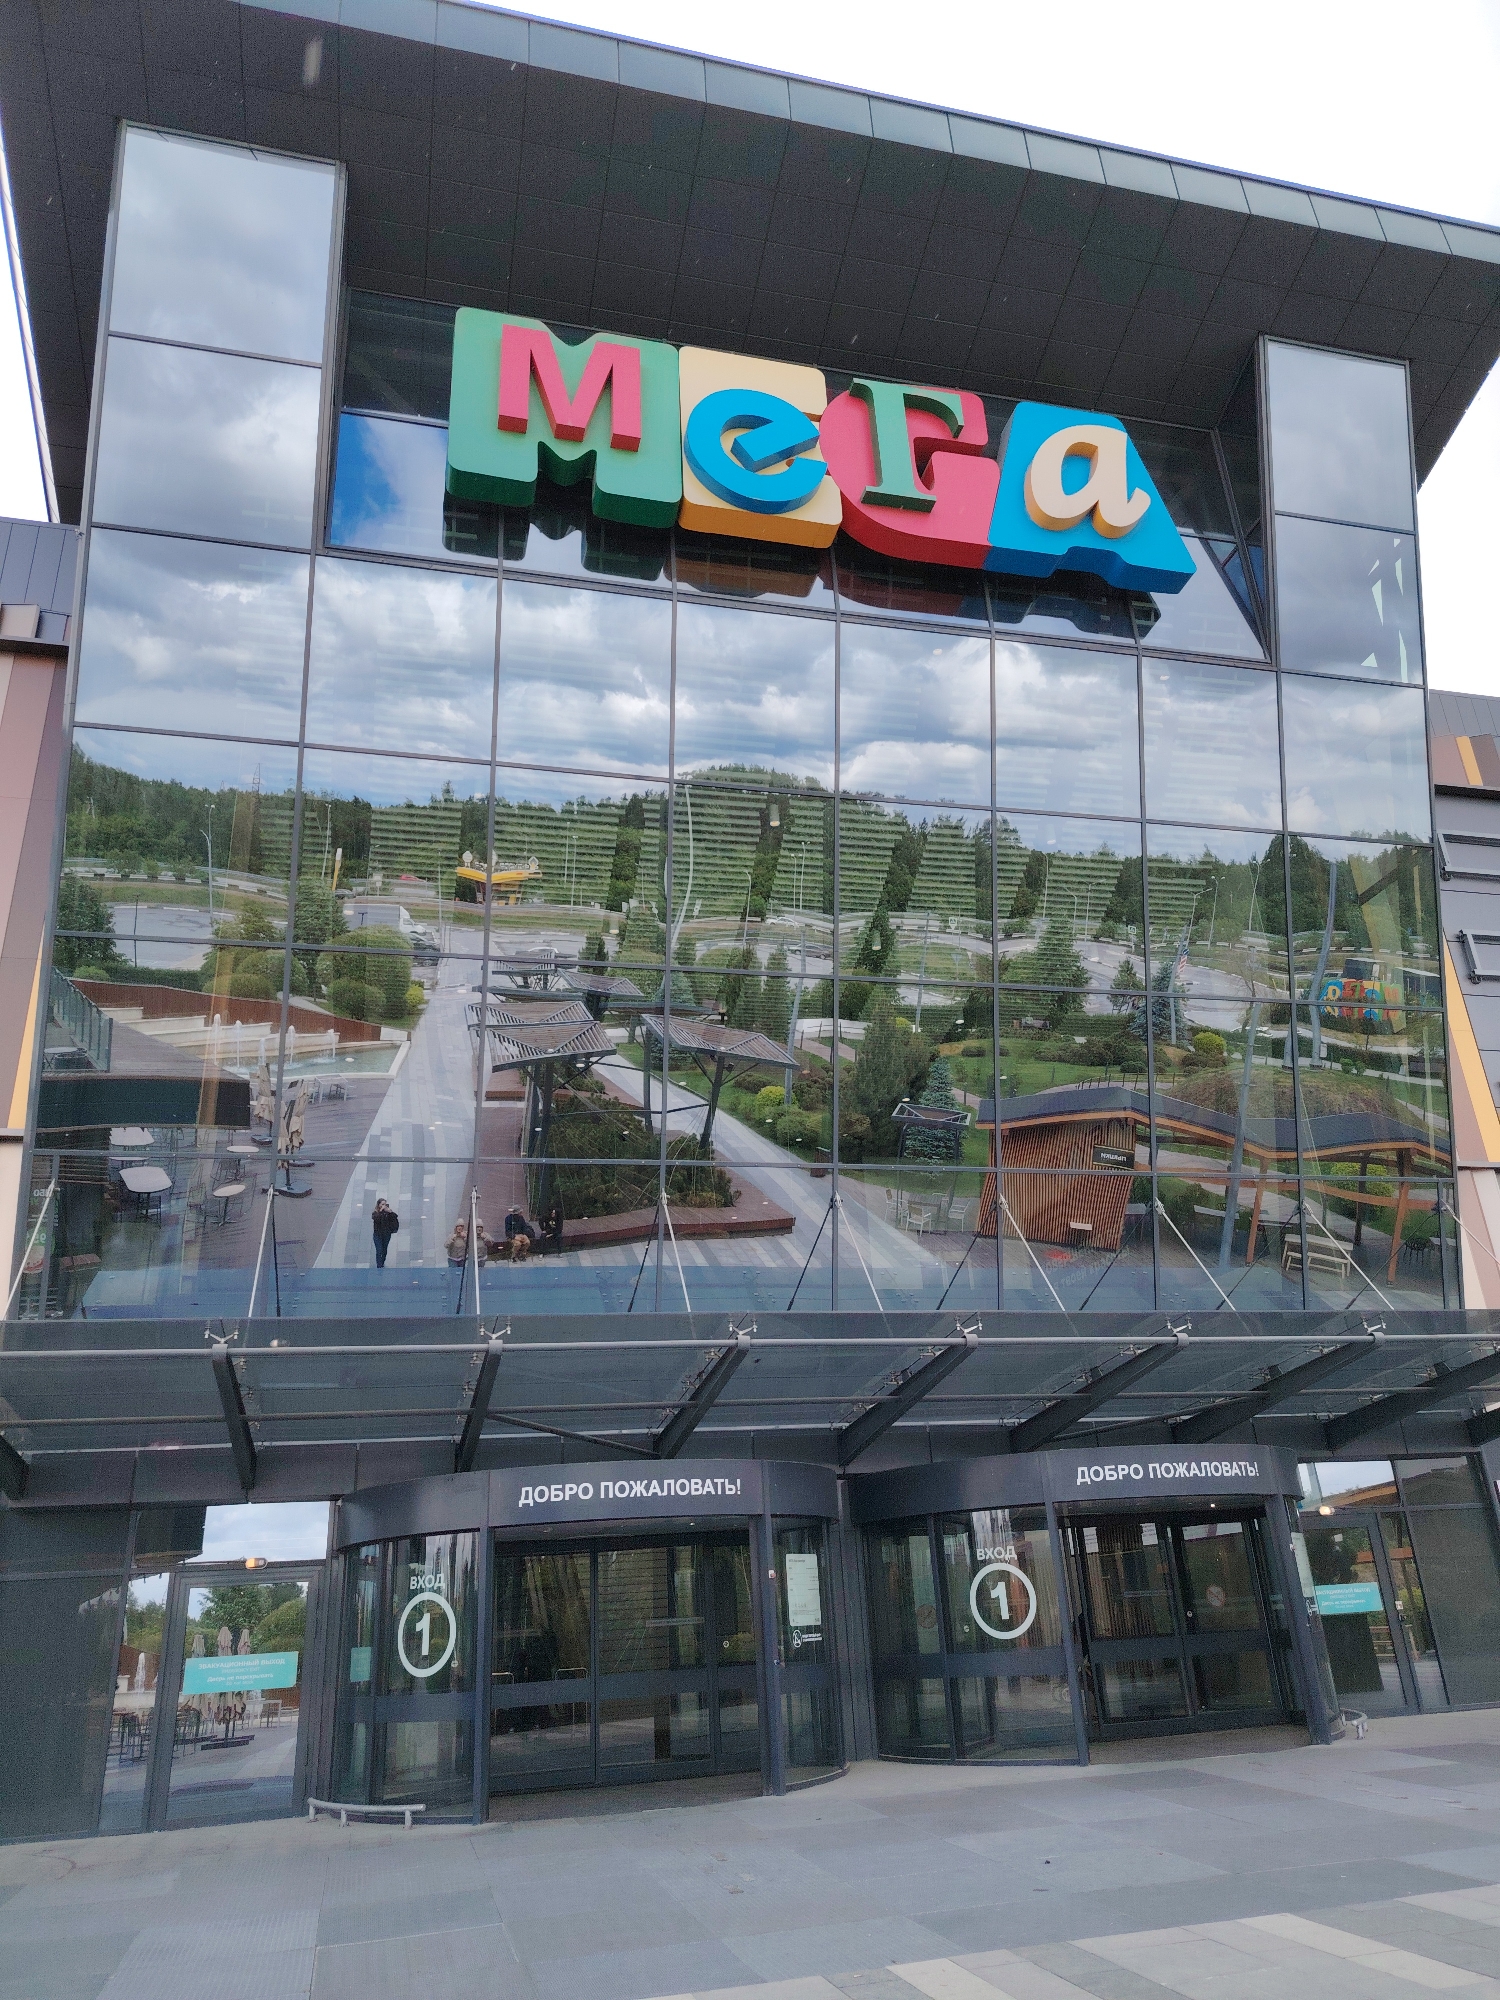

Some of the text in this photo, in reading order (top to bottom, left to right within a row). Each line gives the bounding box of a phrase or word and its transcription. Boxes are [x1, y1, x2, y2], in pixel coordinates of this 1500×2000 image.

[1076, 1461, 1260, 1486] ДОБРО ПОЖАЛОВАТЬ!
[518, 1478, 741, 1508] ДОБРО ПОЖАЛОВАТЬ!
[976, 1545, 1018, 1561] ВХОД
[409, 1573, 446, 1590] ВХОД
[990, 1581, 1010, 1620] 1
[415, 1612, 431, 1656] 1
[198, 1660, 259, 1669] ЭВАКУАЦИОННЫЙ
